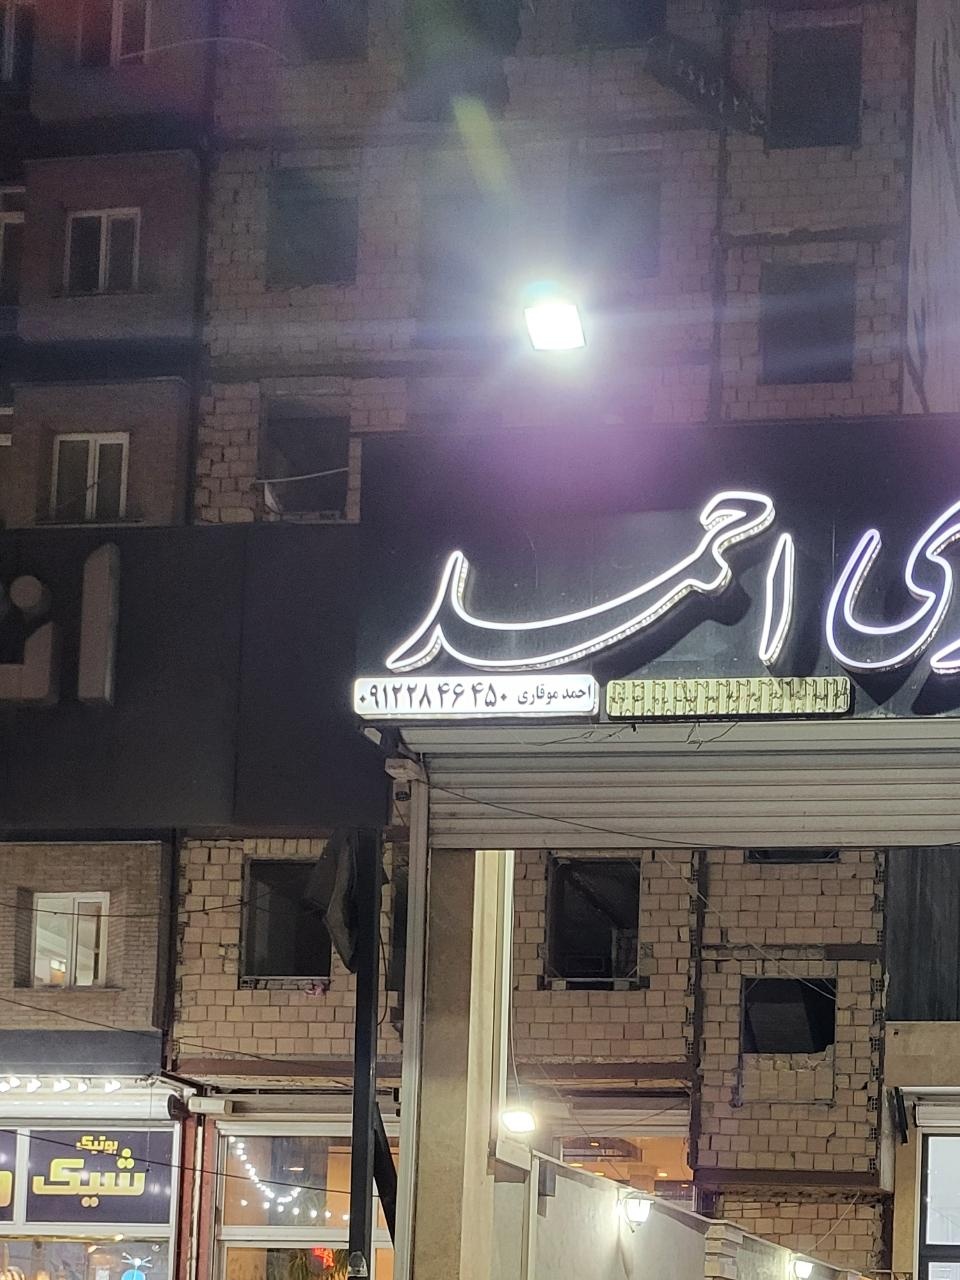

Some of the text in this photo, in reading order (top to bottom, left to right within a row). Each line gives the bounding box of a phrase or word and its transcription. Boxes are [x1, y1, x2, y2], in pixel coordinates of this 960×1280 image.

[385, 490, 796, 672] احمد
[562, 683, 591, 699] احمد
[76, 1135, 119, 1155] بوتیک
[32, 1148, 146, 1208] شیک
